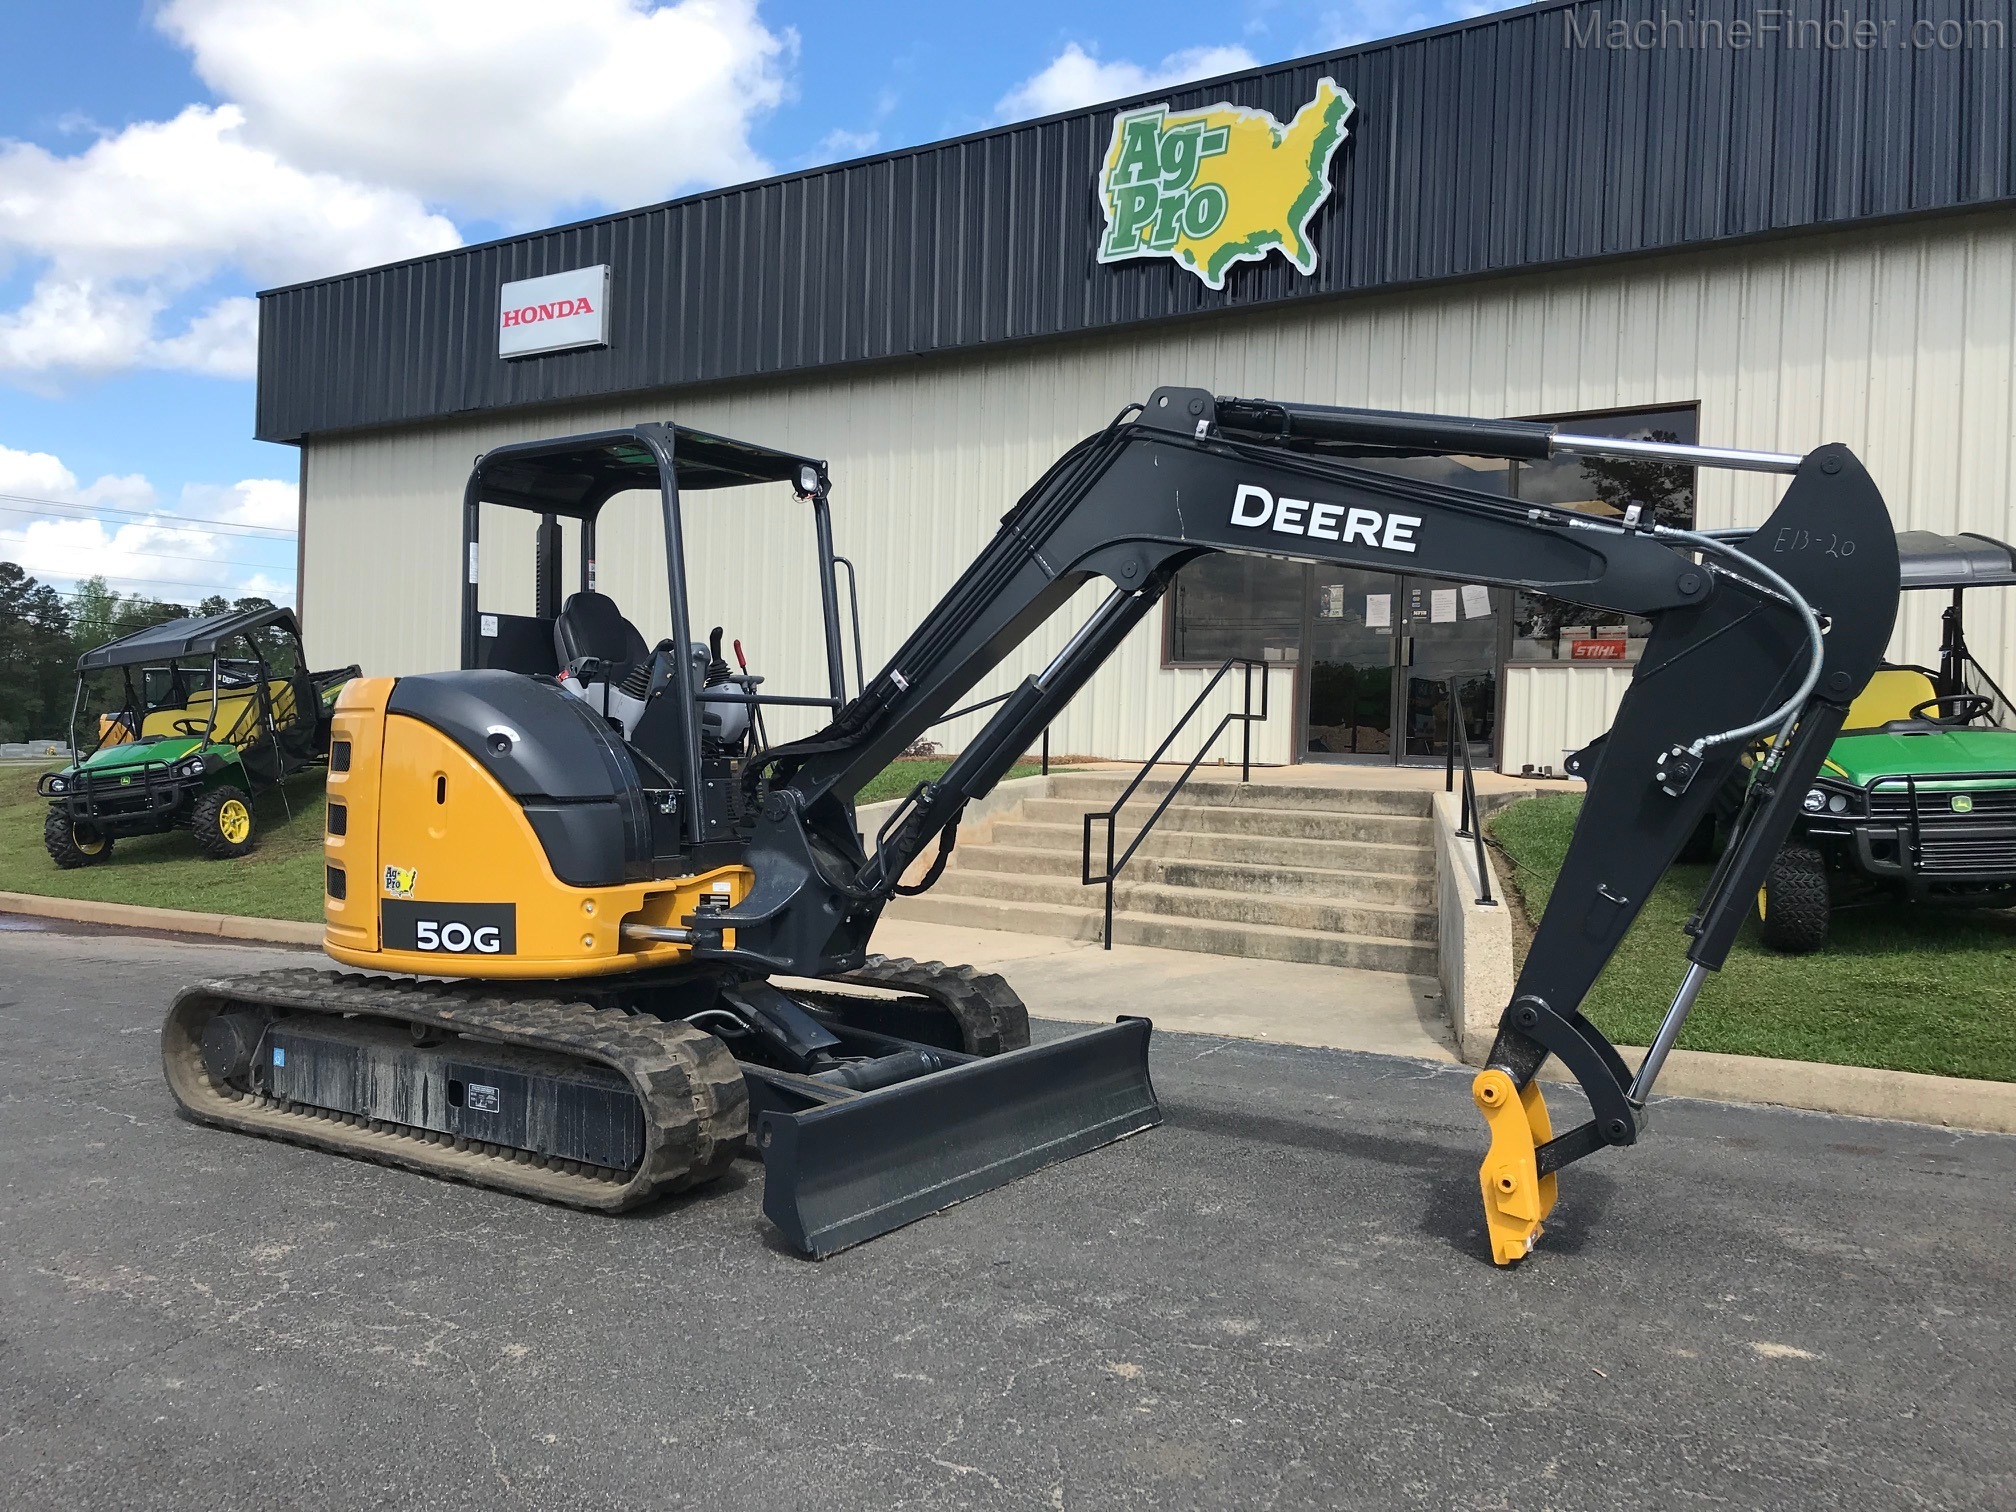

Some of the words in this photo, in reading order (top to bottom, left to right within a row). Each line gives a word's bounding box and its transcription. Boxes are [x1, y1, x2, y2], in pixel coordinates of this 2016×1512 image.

[1108, 111, 1230, 193] Ag-
[1106, 182, 1228, 255] Pro
[502, 297, 594, 328] HONDA
[1230, 483, 1422, 553] DEERE
[1575, 645, 1618, 656] STIHL
[385, 877, 401, 889] Pro
[417, 921, 500, 953] 50G
